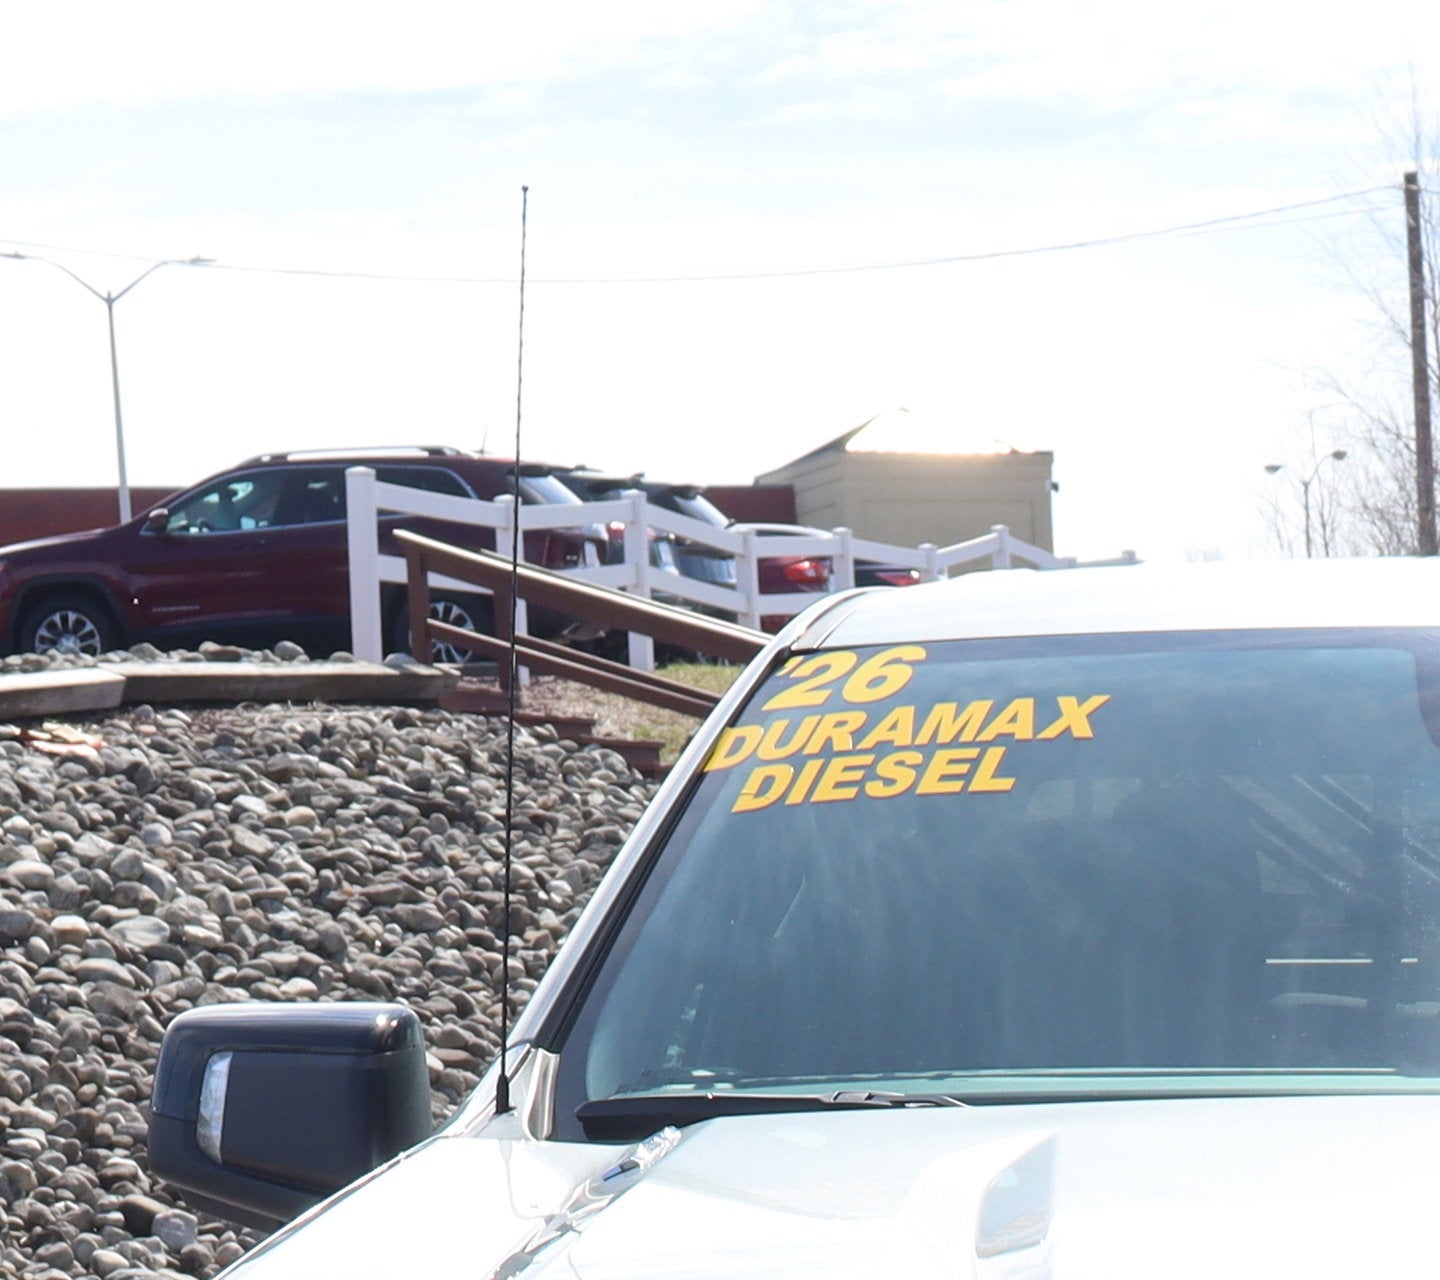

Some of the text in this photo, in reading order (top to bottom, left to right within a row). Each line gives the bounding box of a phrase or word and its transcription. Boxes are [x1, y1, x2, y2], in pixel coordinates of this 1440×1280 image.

[761, 645, 928, 711] '26
[703, 694, 1111, 773] DURAMAX
[731, 746, 1017, 813] DIESEL
